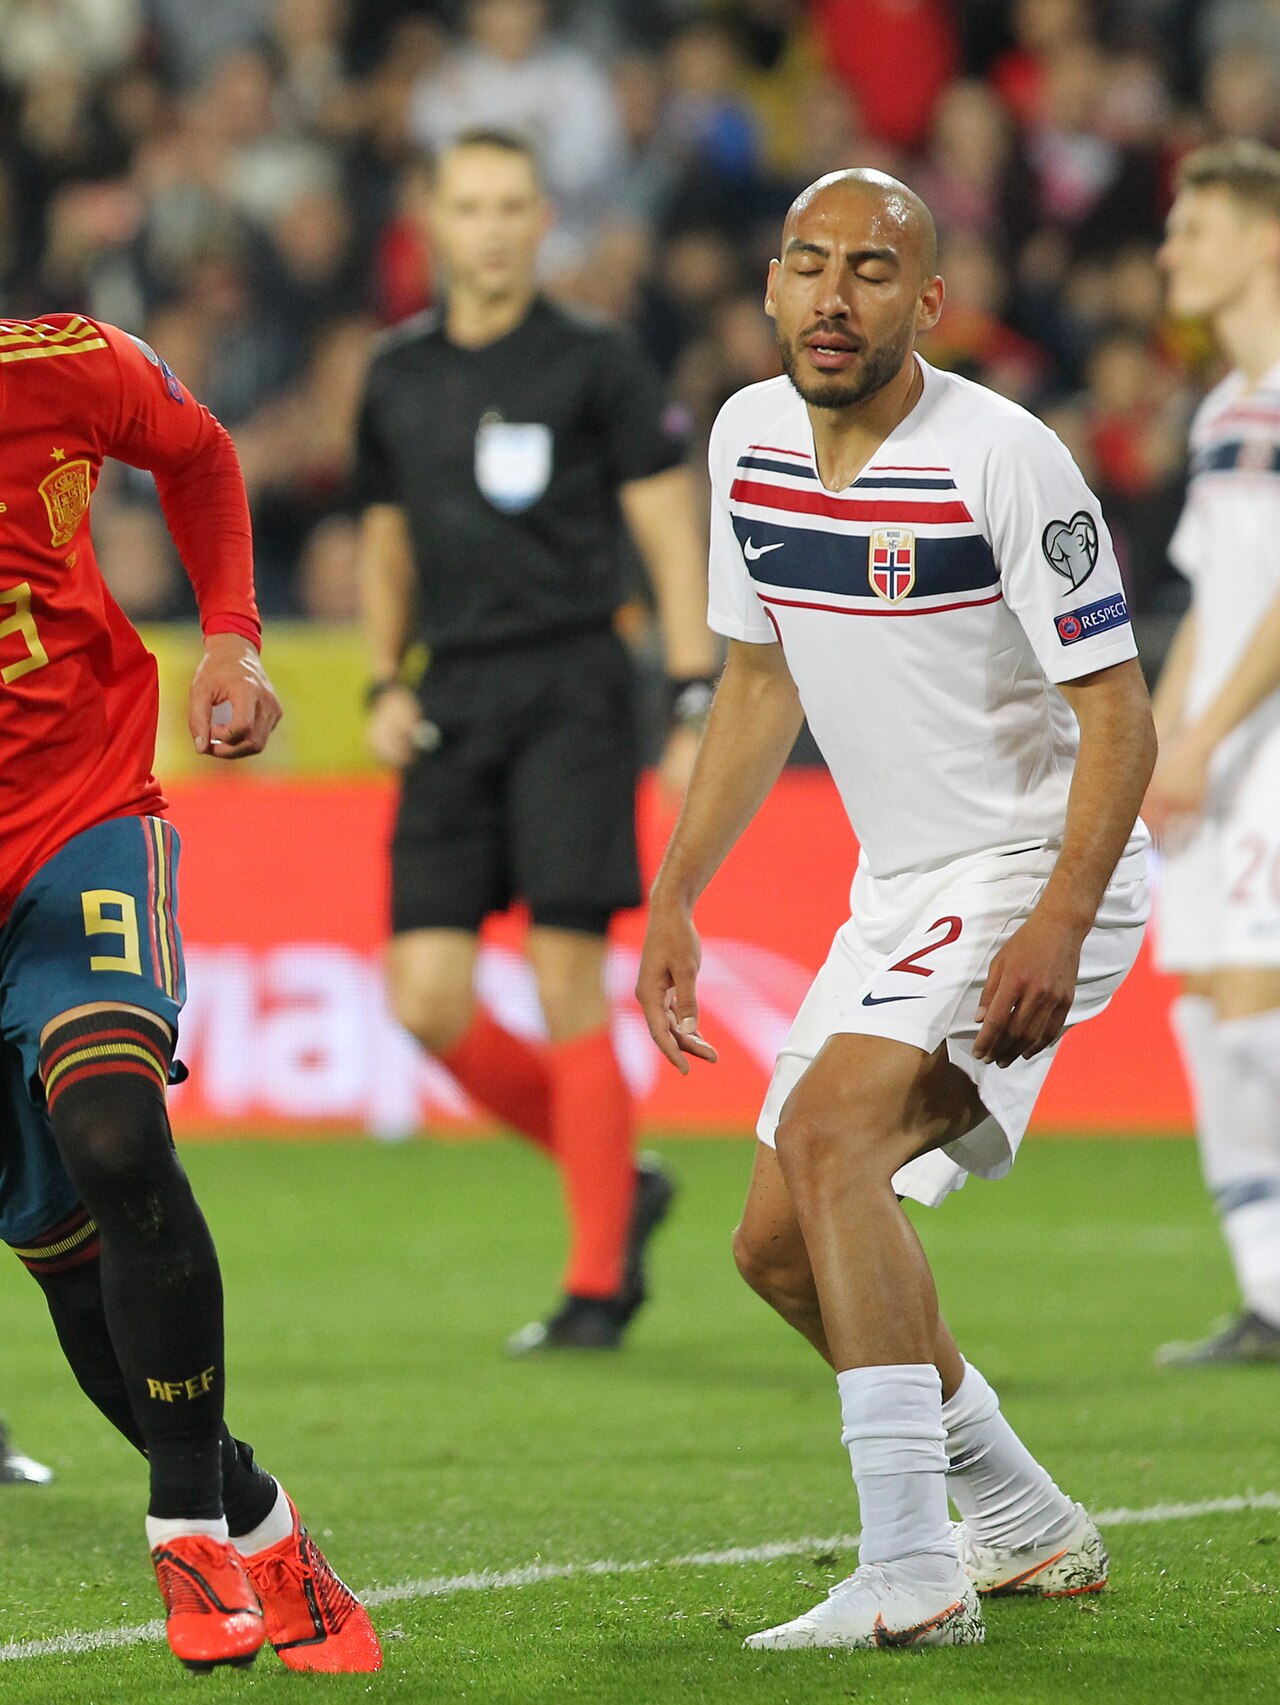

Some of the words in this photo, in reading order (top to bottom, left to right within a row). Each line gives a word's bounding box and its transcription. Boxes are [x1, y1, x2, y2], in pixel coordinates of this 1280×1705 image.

[1080, 601, 1128, 630] RESPECT
[81, 888, 142, 977] 9
[886, 915, 963, 978] 2
